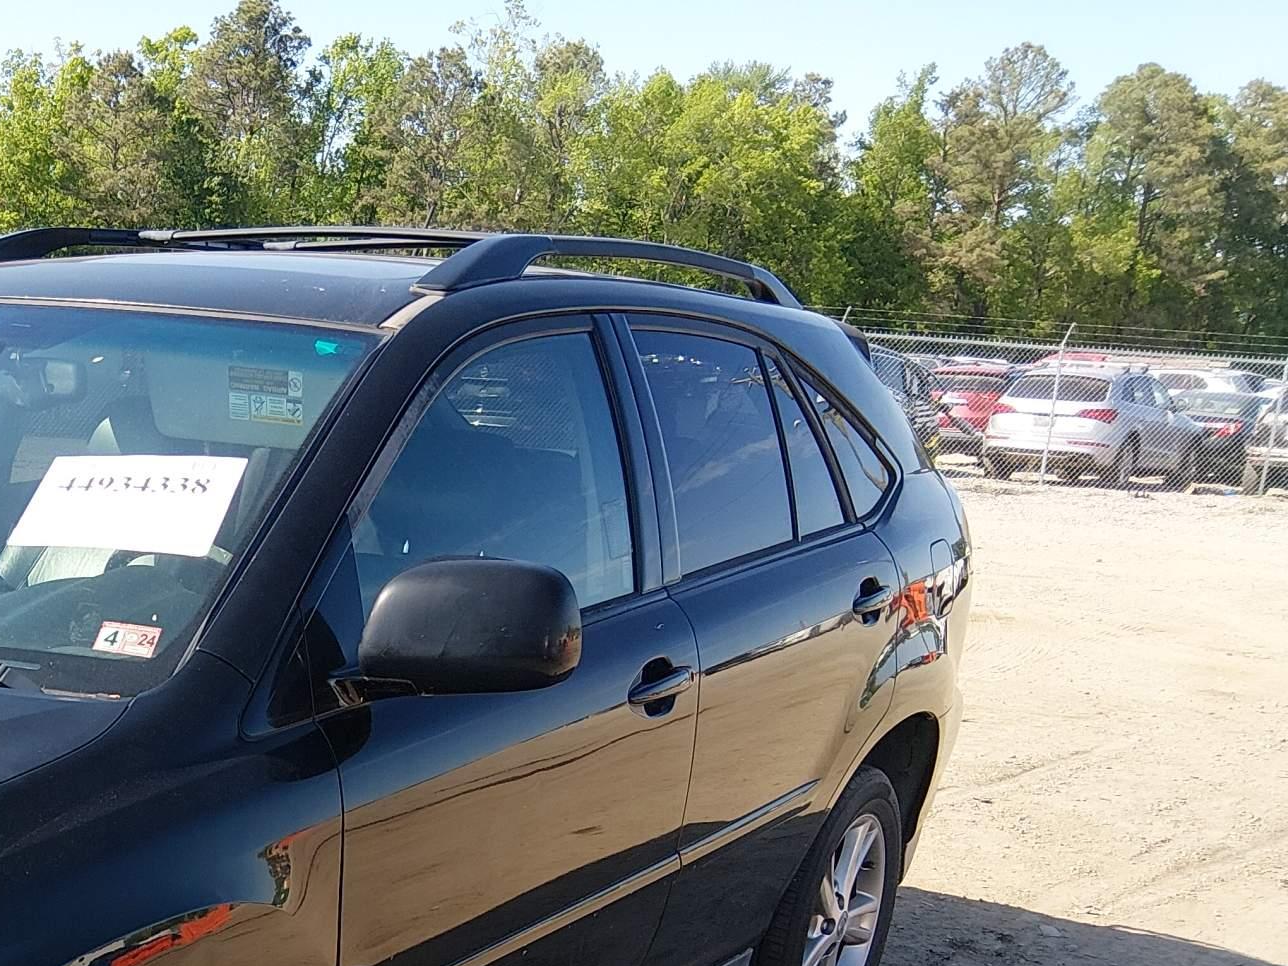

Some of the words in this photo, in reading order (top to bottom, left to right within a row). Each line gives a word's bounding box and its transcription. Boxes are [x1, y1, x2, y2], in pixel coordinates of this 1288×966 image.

[57, 474, 211, 494] 44934338
[103, 630, 119, 646] 4
[137, 633, 156, 647] 24
